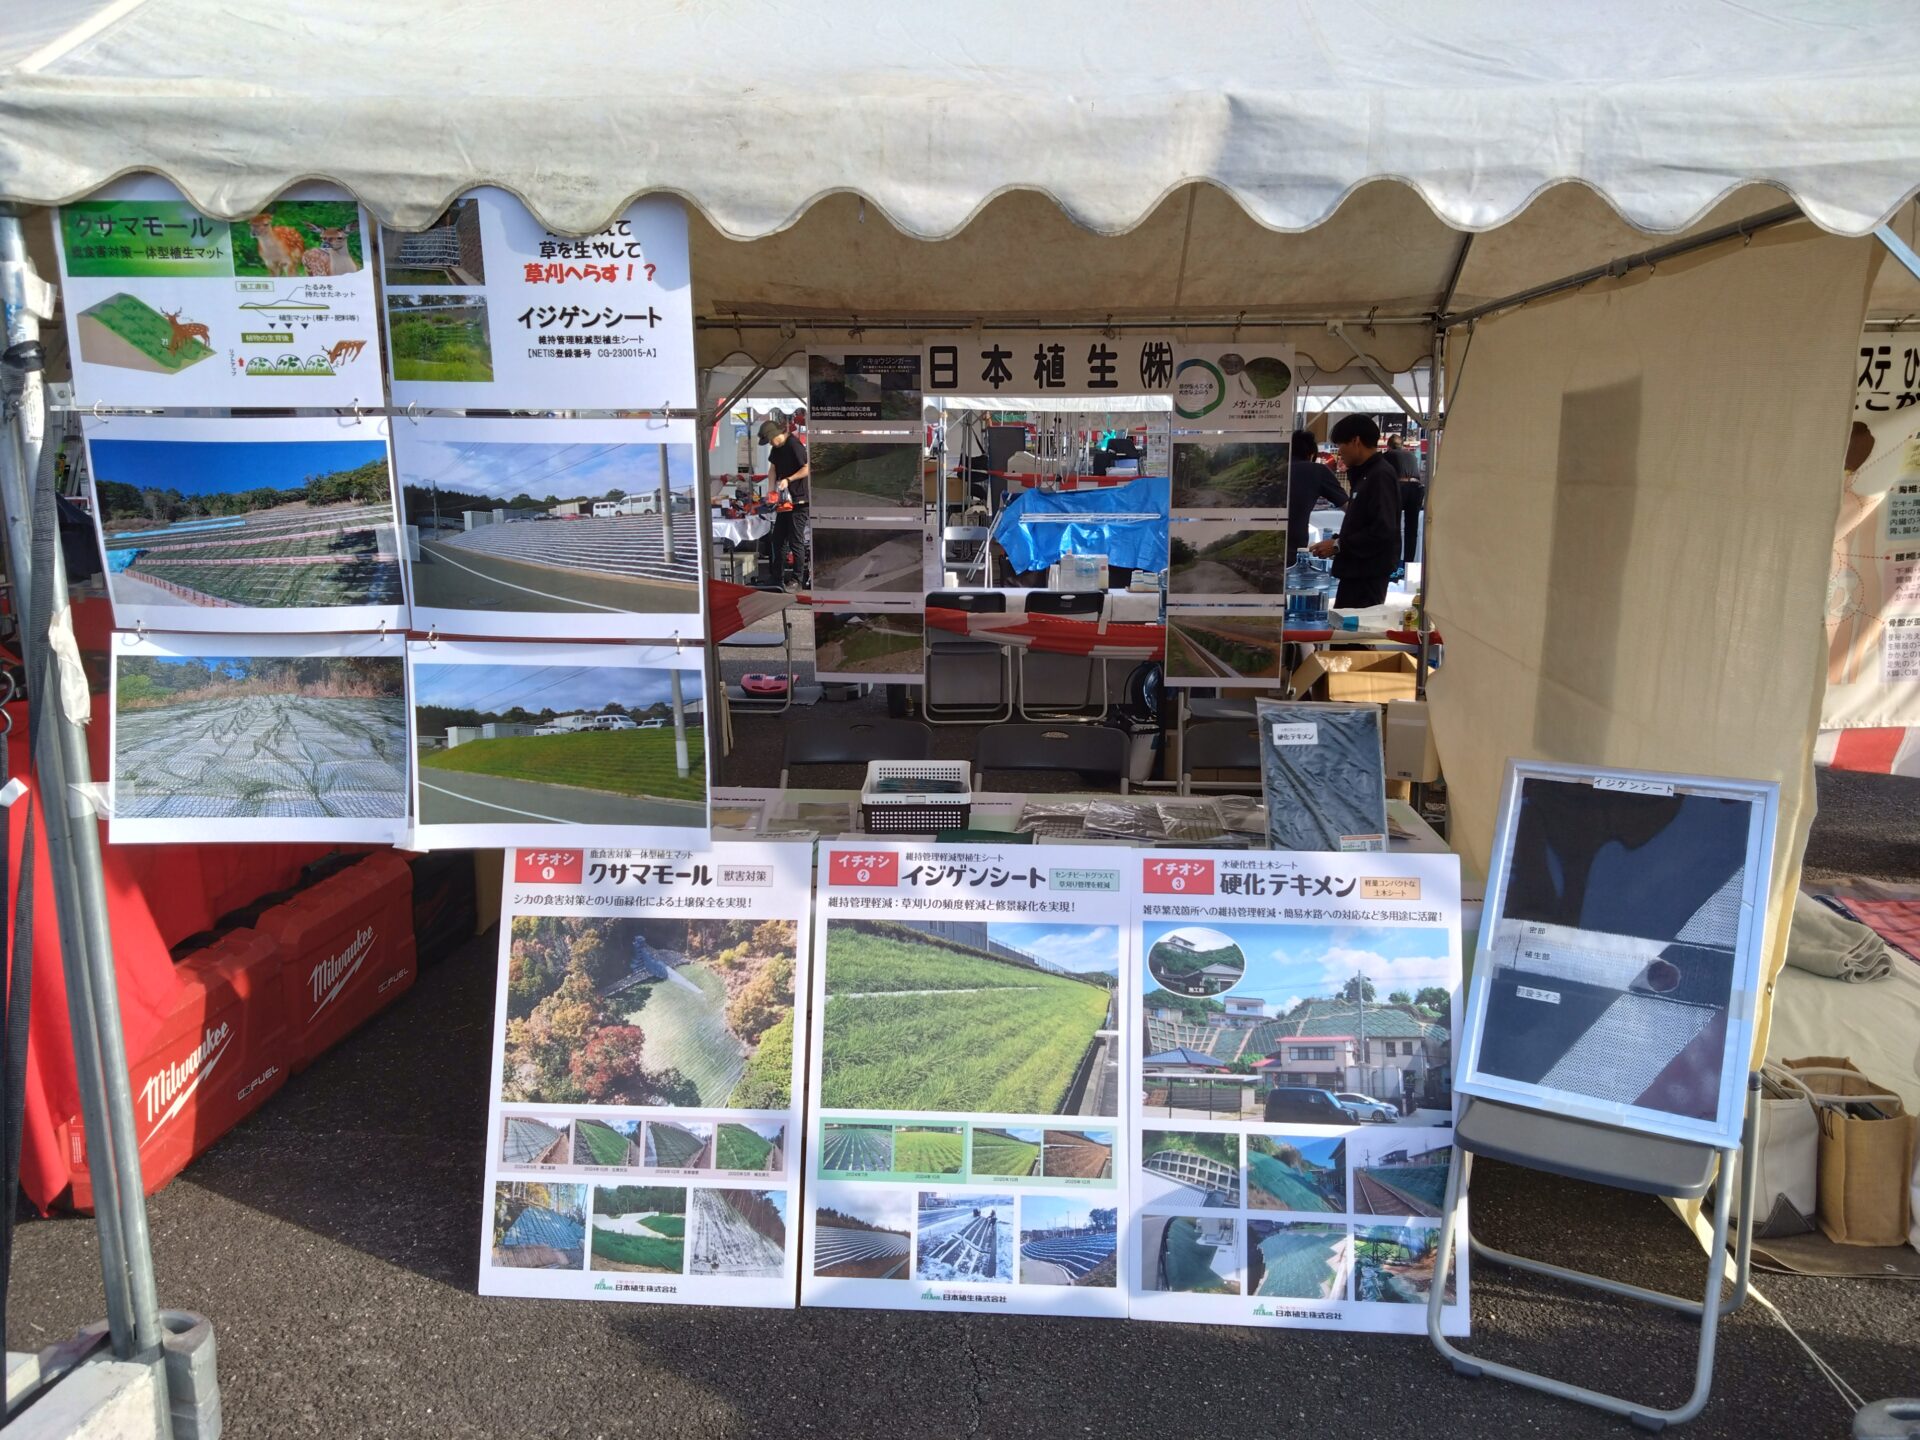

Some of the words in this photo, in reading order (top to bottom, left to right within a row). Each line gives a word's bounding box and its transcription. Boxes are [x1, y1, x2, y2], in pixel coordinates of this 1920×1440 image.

[75, 214, 213, 239] クサマモール
[539, 240, 641, 260] 草を生やして
[517, 306, 662, 329] イジゲンシート
[1594, 778, 1673, 796] イジゲンシート
[523, 852, 575, 867] イチオシ
[838, 855, 891, 868] イチオシ
[905, 851, 1004, 863] 維持管理軽減型植生シート
[1221, 859, 1298, 870] 水硬化性土木シート
[588, 863, 713, 886] クサマモール
[723, 870, 767, 882] 獣害対策
[901, 865, 1046, 889] イジゲンシート
[1152, 862, 1205, 876] イチオシ
[1220, 872, 1357, 897] 硬化テキメン
[307, 925, 374, 1003] Milwaukee
[388, 967, 409, 987] FUEL
[137, 1021, 230, 1123] Milwaukee
[251, 1065, 279, 1091] FUEL
